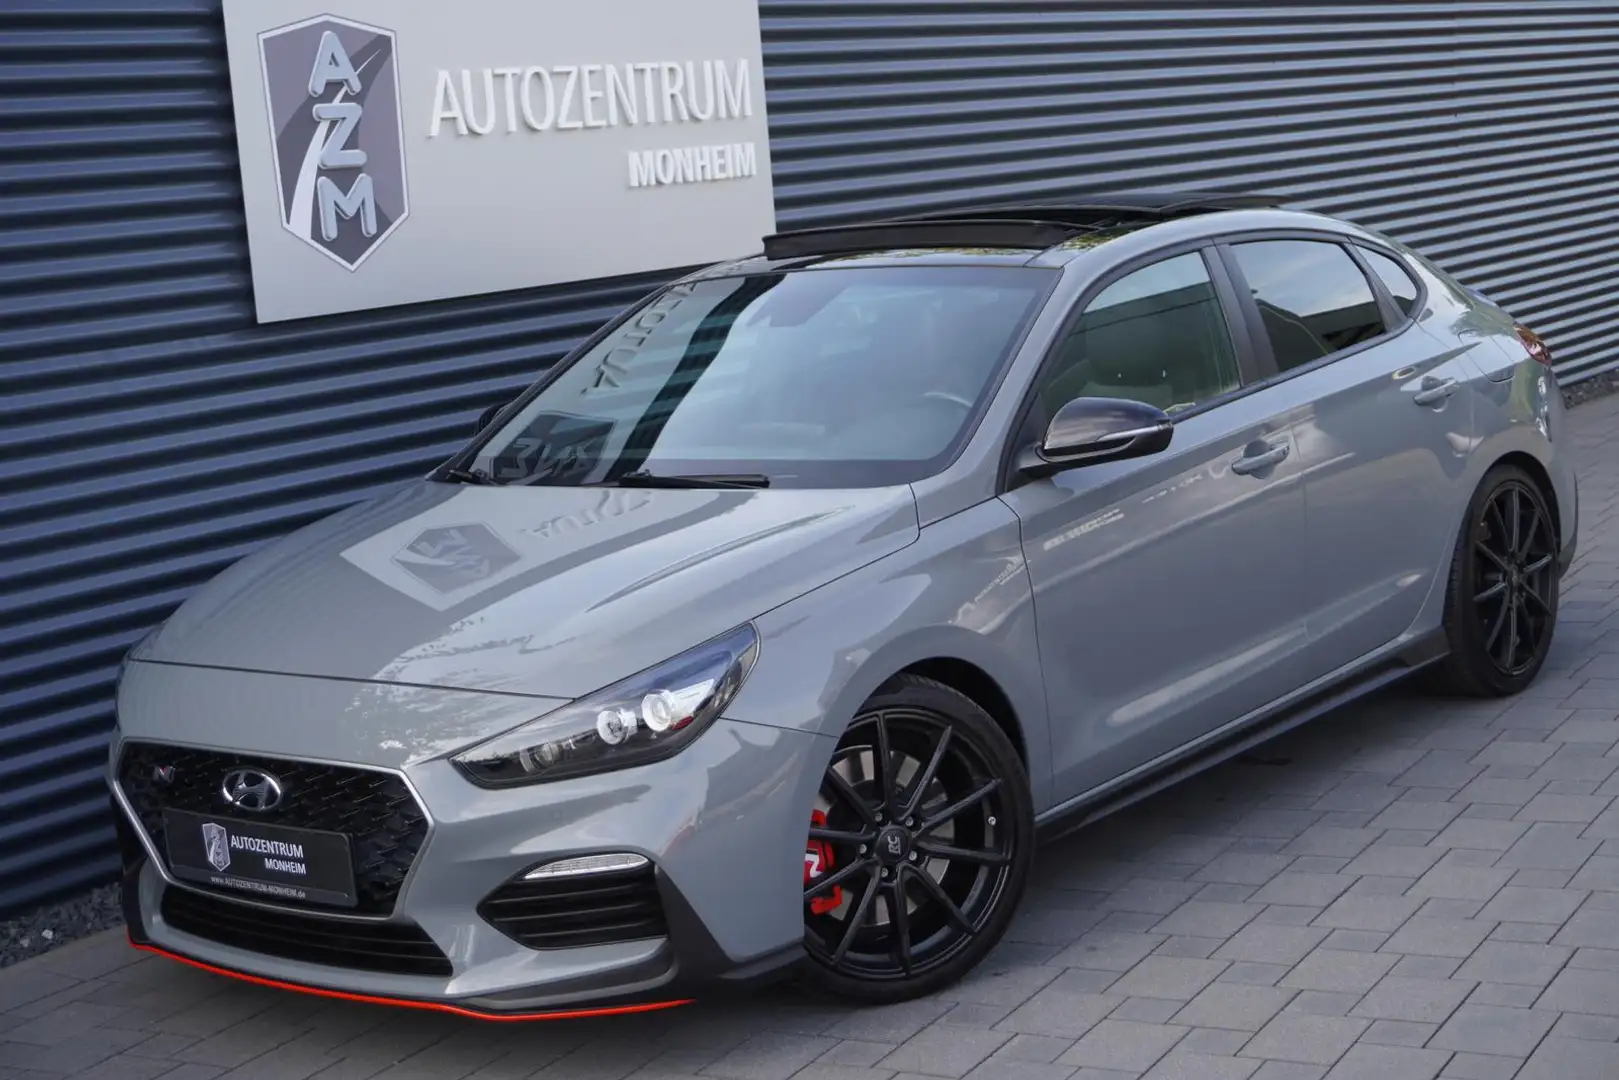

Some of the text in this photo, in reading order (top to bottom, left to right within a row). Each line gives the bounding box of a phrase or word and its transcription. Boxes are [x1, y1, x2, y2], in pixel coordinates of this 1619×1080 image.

[427, 58, 753, 137] AUTOZENTRUM
[628, 142, 757, 188] MONHEIM
[230, 835, 304, 858] AUTOZENTRUM
[264, 858, 307, 874] MONHEIM
[210, 876, 306, 898] www.AUTOZENTRUM-MONHEIM.de
